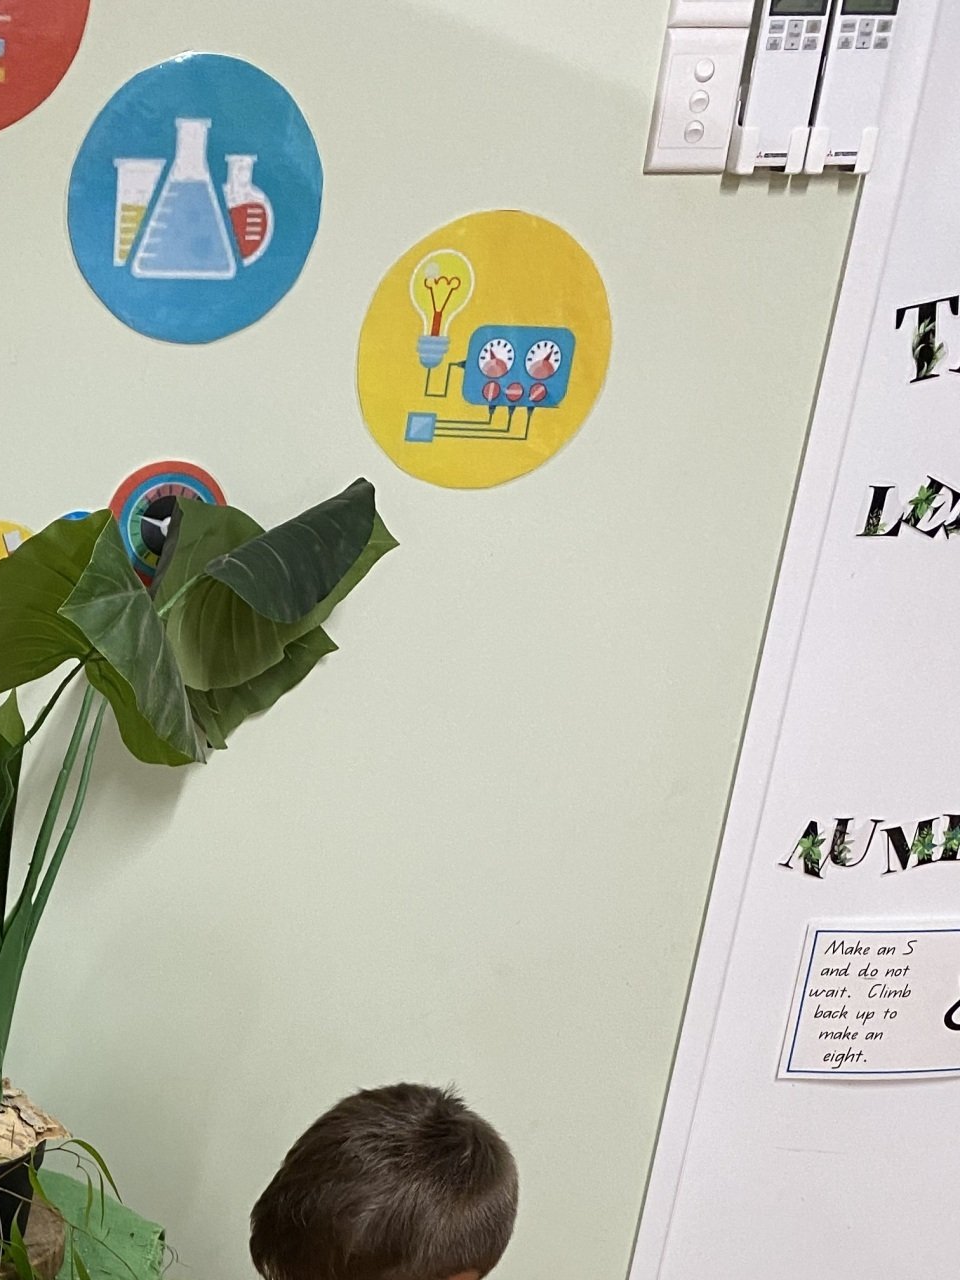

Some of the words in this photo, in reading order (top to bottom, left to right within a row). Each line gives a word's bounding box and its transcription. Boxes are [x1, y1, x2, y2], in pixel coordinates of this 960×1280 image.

[895, 295, 960, 383] T
[856, 474, 960, 539] LE
[824, 940, 870, 955] Make
[877, 946, 896, 955] an
[902, 940, 918, 955] S
[820, 962, 851, 977] and
[858, 962, 878, 977] do
[885, 965, 911, 977] not
[808, 986, 851, 998] wait.
[868, 983, 911, 998] Climb
[814, 1004, 848, 1019] back
[856, 1012, 875, 1026] up
[883, 1008, 898, 1019] to
[819, 1026, 859, 1040] make
[865, 1031, 884, 1040] an
[823, 1047, 867, 1069] eight.
